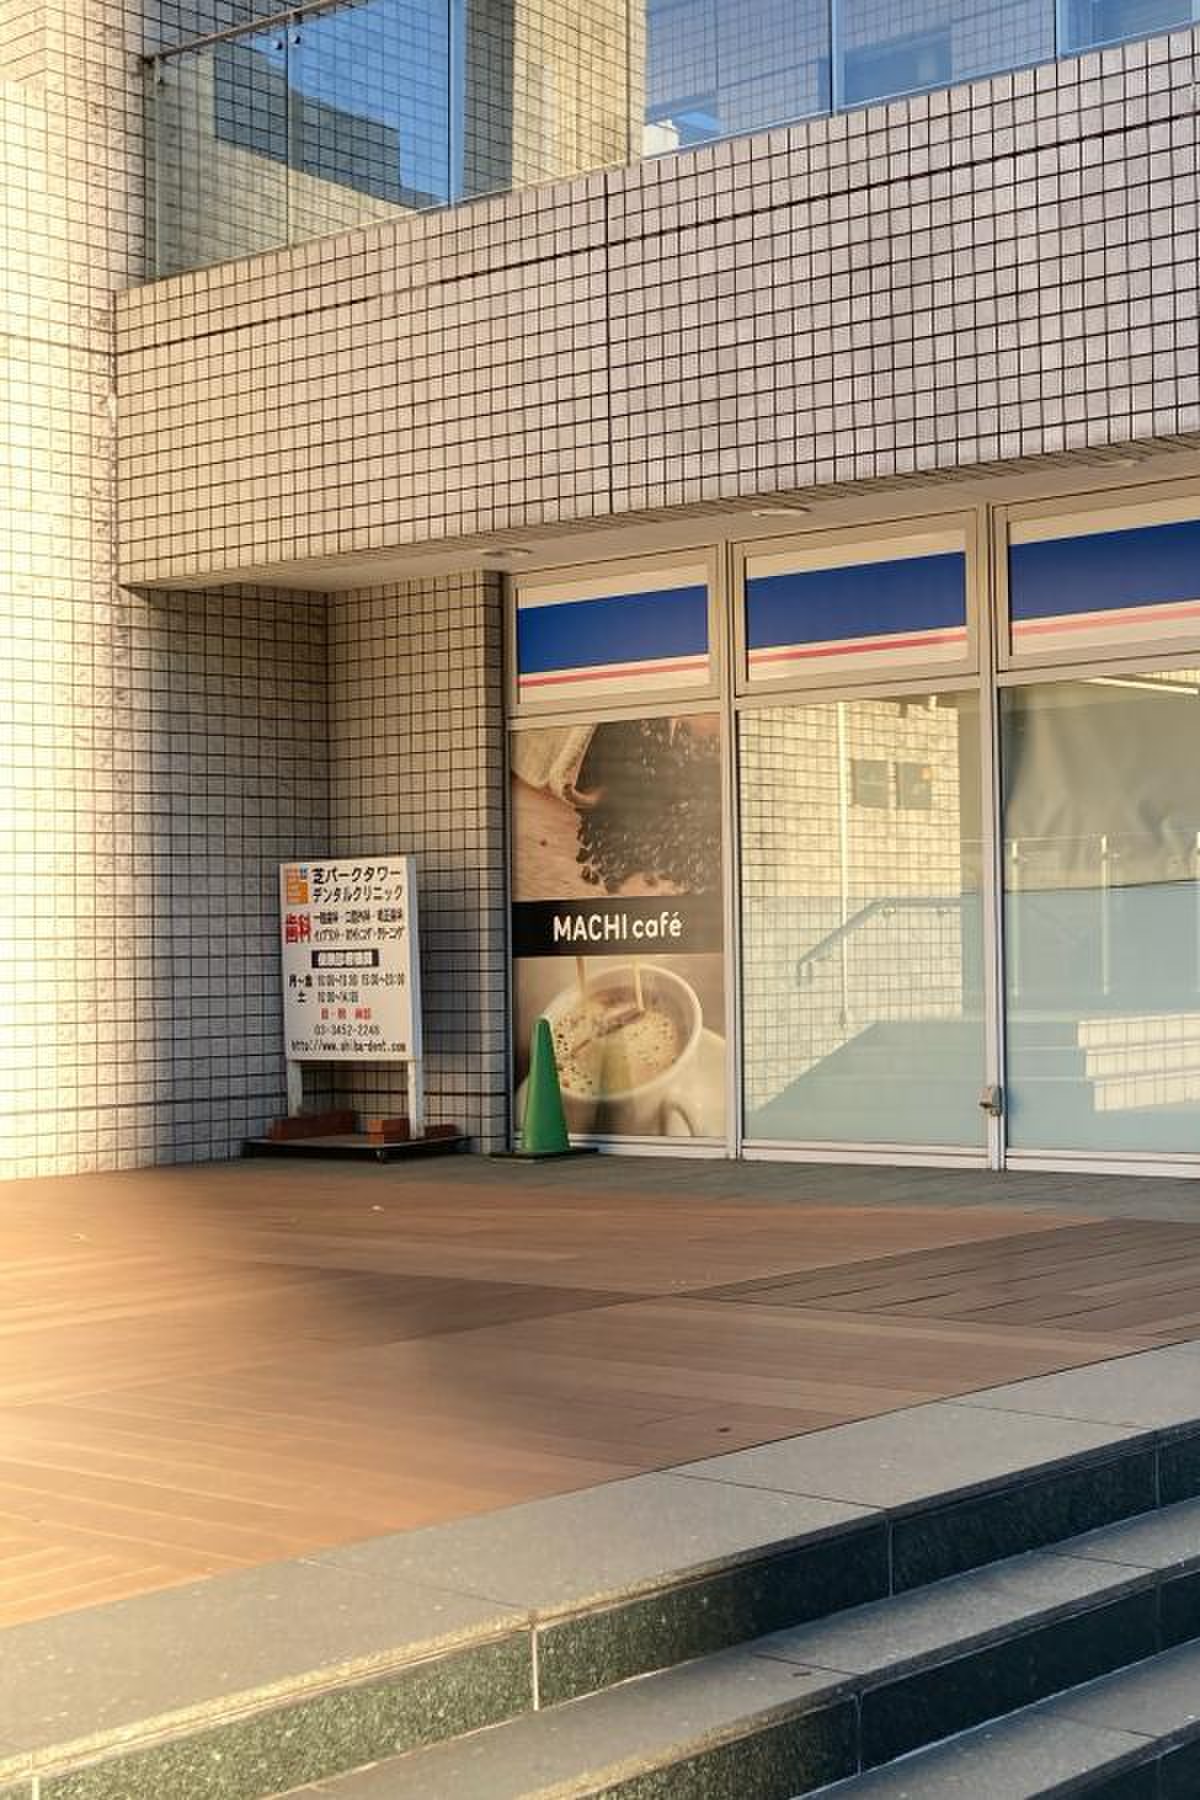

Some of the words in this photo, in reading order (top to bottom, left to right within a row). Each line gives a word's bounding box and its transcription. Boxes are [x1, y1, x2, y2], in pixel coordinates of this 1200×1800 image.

[312, 865, 401, 885] 芝パークタワー
[313, 884, 403, 903] デンタルクリニック
[553, 914, 628, 942] MACHI
[632, 911, 683, 939] café
